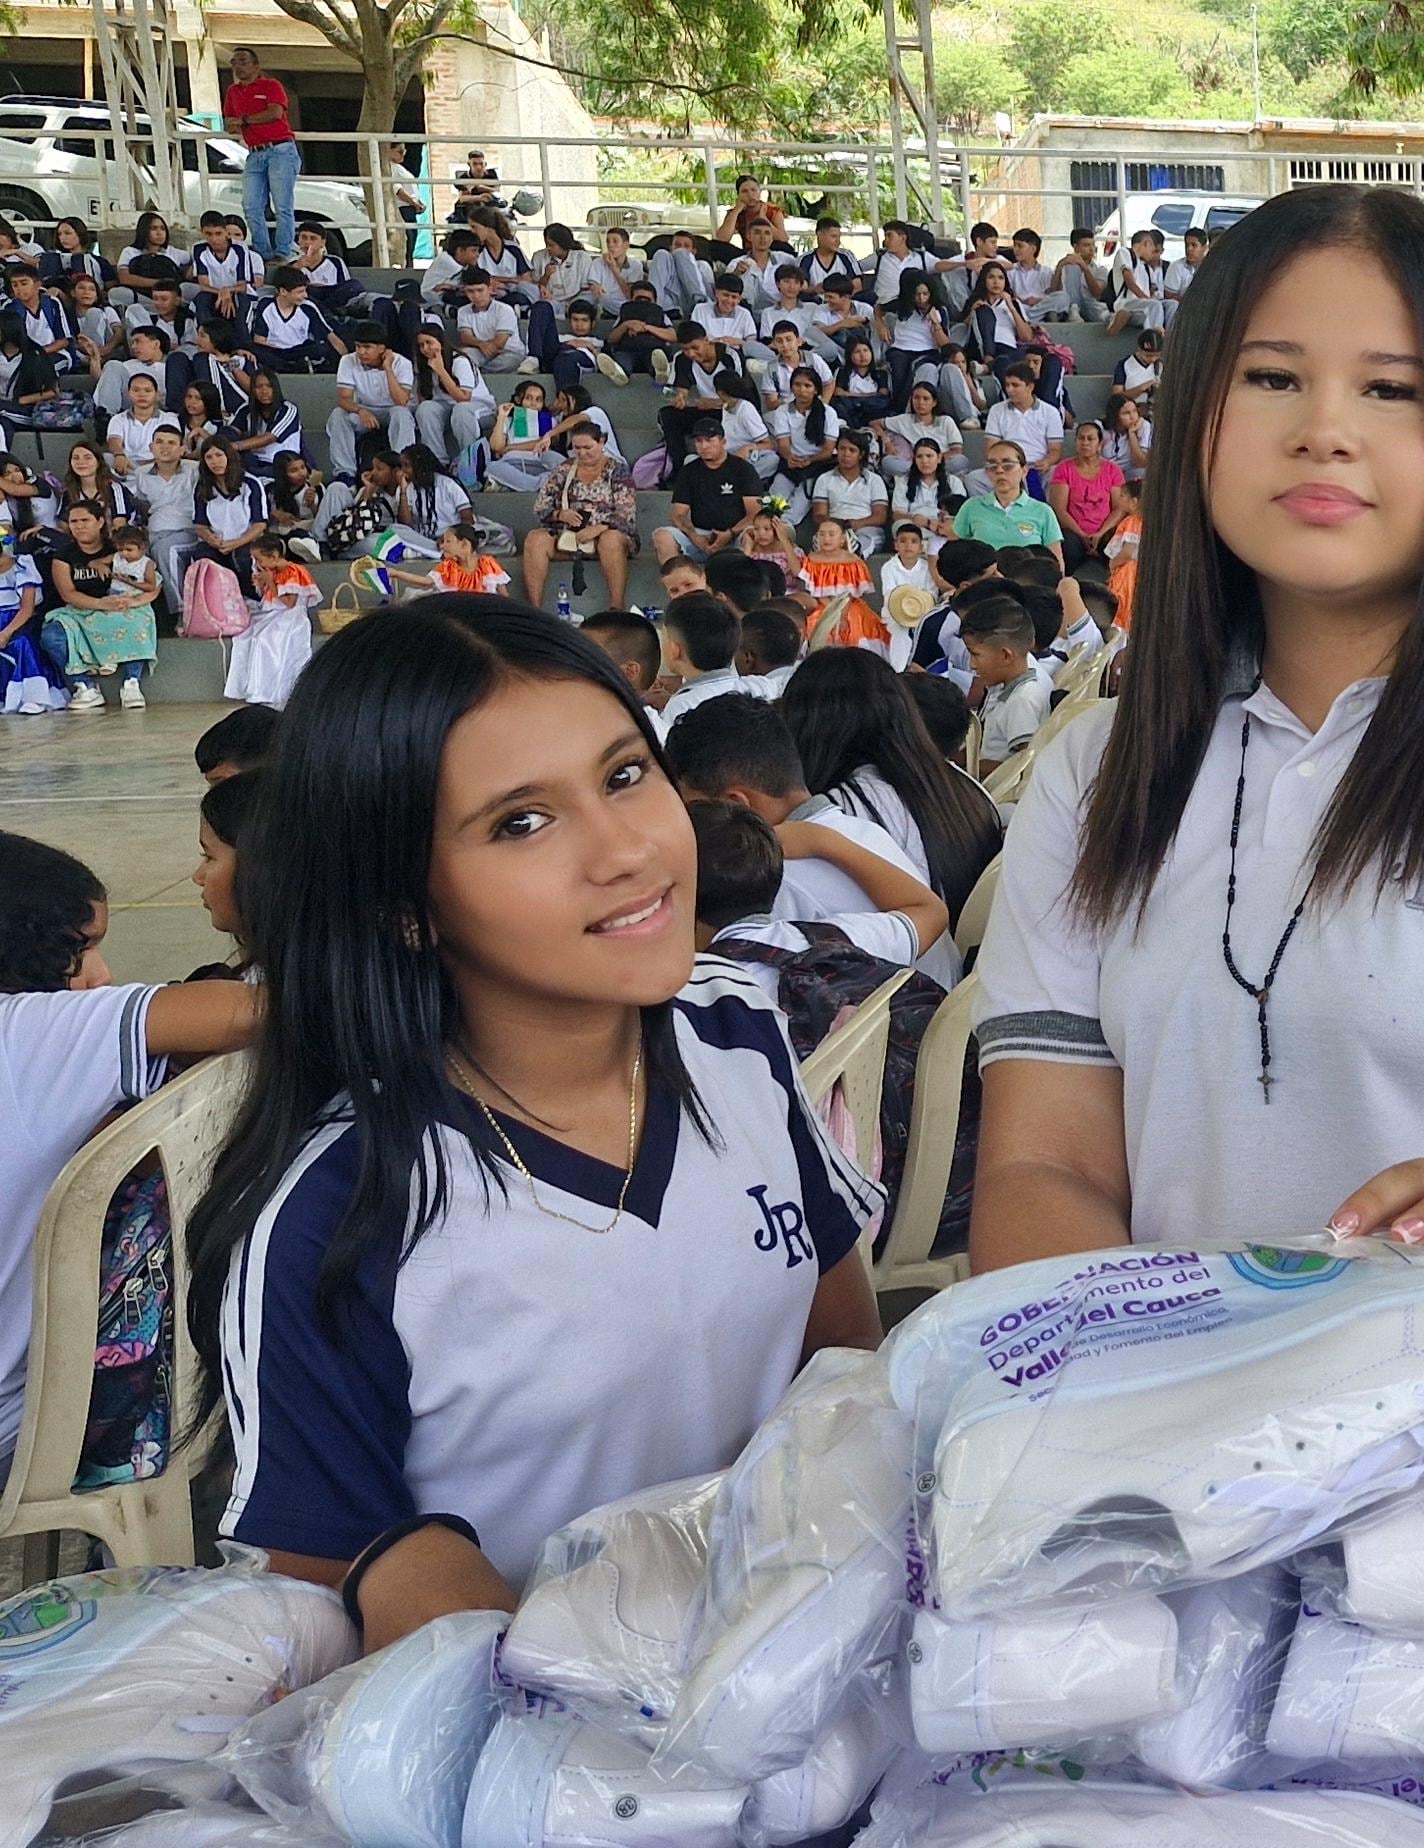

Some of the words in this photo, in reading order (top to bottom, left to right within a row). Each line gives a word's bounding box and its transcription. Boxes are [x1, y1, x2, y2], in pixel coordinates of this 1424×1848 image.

[745, 1184, 813, 1268] JR
[1172, 1267, 1211, 1285] del
[979, 1252, 1201, 1347] GOBEACIÓN
[1122, 1287, 1222, 1316] Cauca
[1104, 1335, 1163, 1353] Fomento
